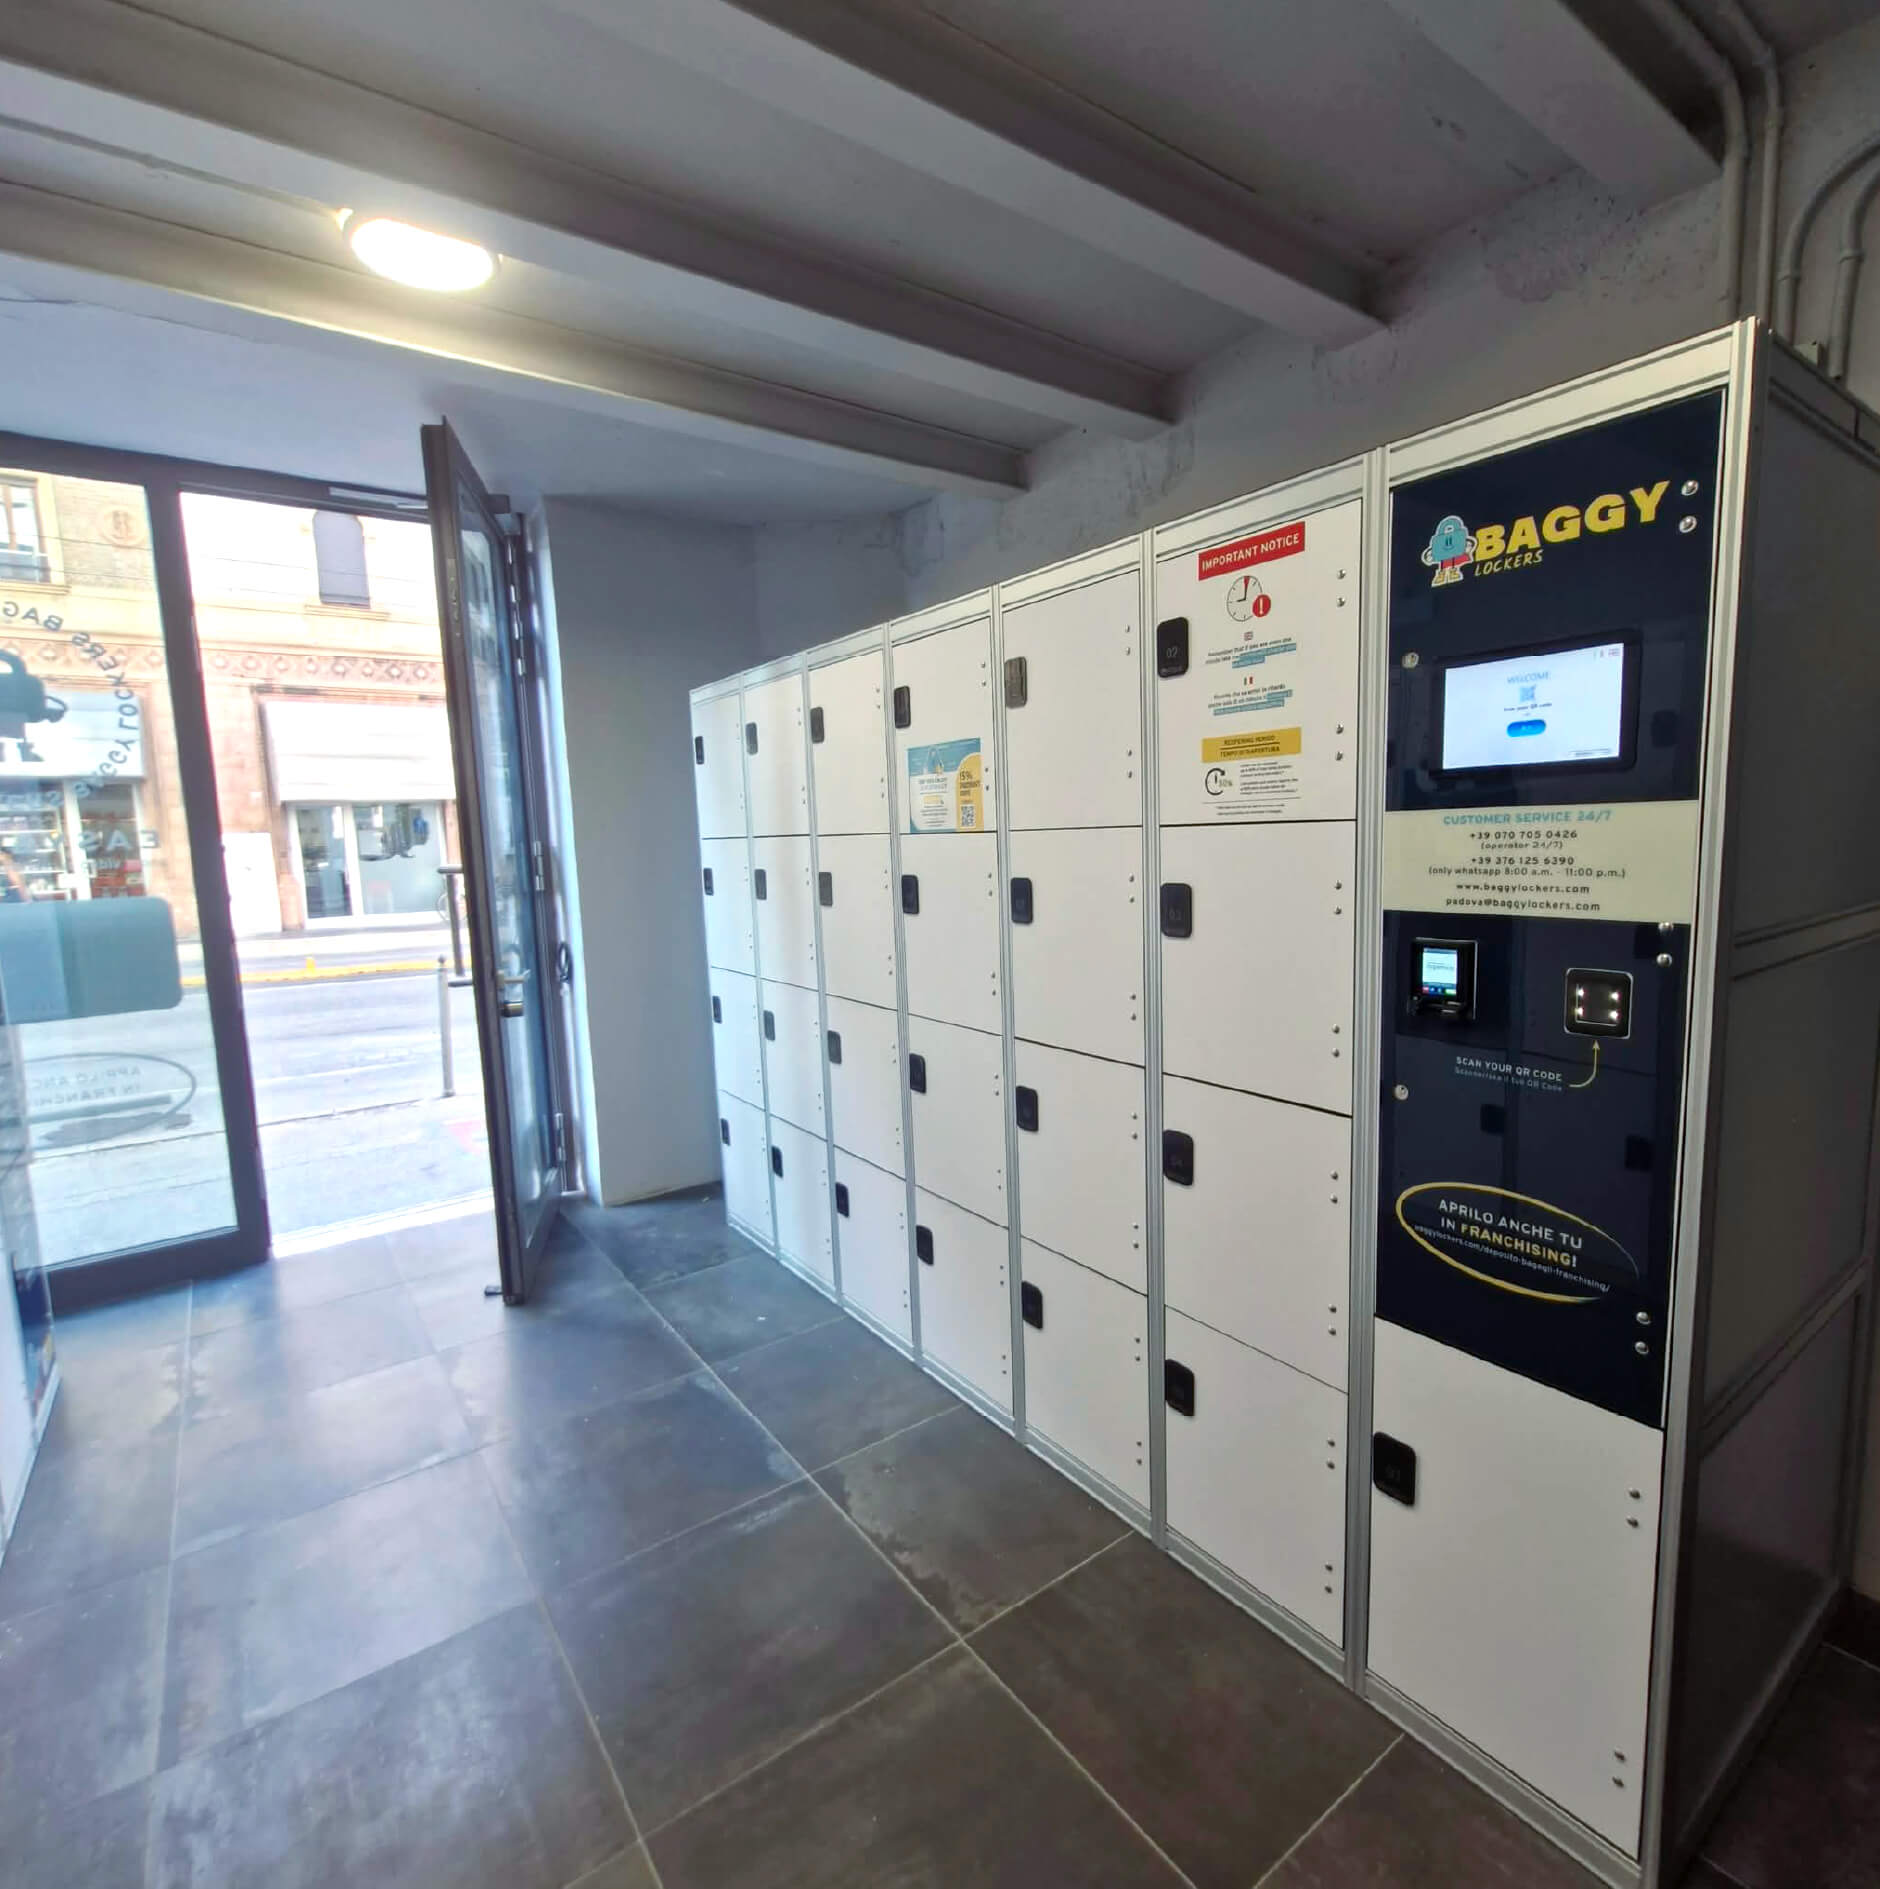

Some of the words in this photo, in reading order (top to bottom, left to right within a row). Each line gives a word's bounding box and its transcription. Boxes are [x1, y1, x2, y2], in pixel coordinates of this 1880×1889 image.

[1475, 480, 1670, 562] BAGGY
[1202, 545, 1259, 572] IMPORTANT
[1260, 533, 1300, 553] NOTICE
[1474, 550, 1544, 577] LOCKERS
[1506, 671, 1550, 684] WELCOME
[1443, 814, 1511, 825] CUSTOMER
[1516, 811, 1572, 823] SERVICE
[1577, 810, 1612, 823] 24/7
[1470, 831, 1490, 840] +39
[1495, 831, 1515, 839] 070
[1520, 830, 1541, 839] 705
[1546, 830, 1578, 839] 0426
[1481, 841, 1529, 850] (operator
[1471, 856, 1491, 865] +39
[1495, 856, 1515, 865] 376
[1519, 856, 1539, 865] 125
[1543, 856, 1575, 865] 6390
[1428, 867, 1452, 876] (only
[1454, 867, 1501, 877] whatsapp
[1565, 867, 1593, 877] 11:00
[1596, 868, 1626, 879] p.m.)
[1456, 883, 1590, 894] www.baggylockers.com
[1446, 898, 1601, 912] padova@baggylockers.com
[1455, 1056, 1482, 1068] SCAN
[1485, 1061, 1513, 1073] YOUR
[1515, 1066, 1531, 1077] QR
[1533, 1069, 1562, 1082] CODE
[1439, 1199, 1494, 1225] APRILO
[1497, 1216, 1555, 1241] ANCHE
[1560, 1232, 1582, 1249] TU
[1440, 1217, 1456, 1232] IN
[1460, 1224, 1578, 1268] FRANCHISING!
